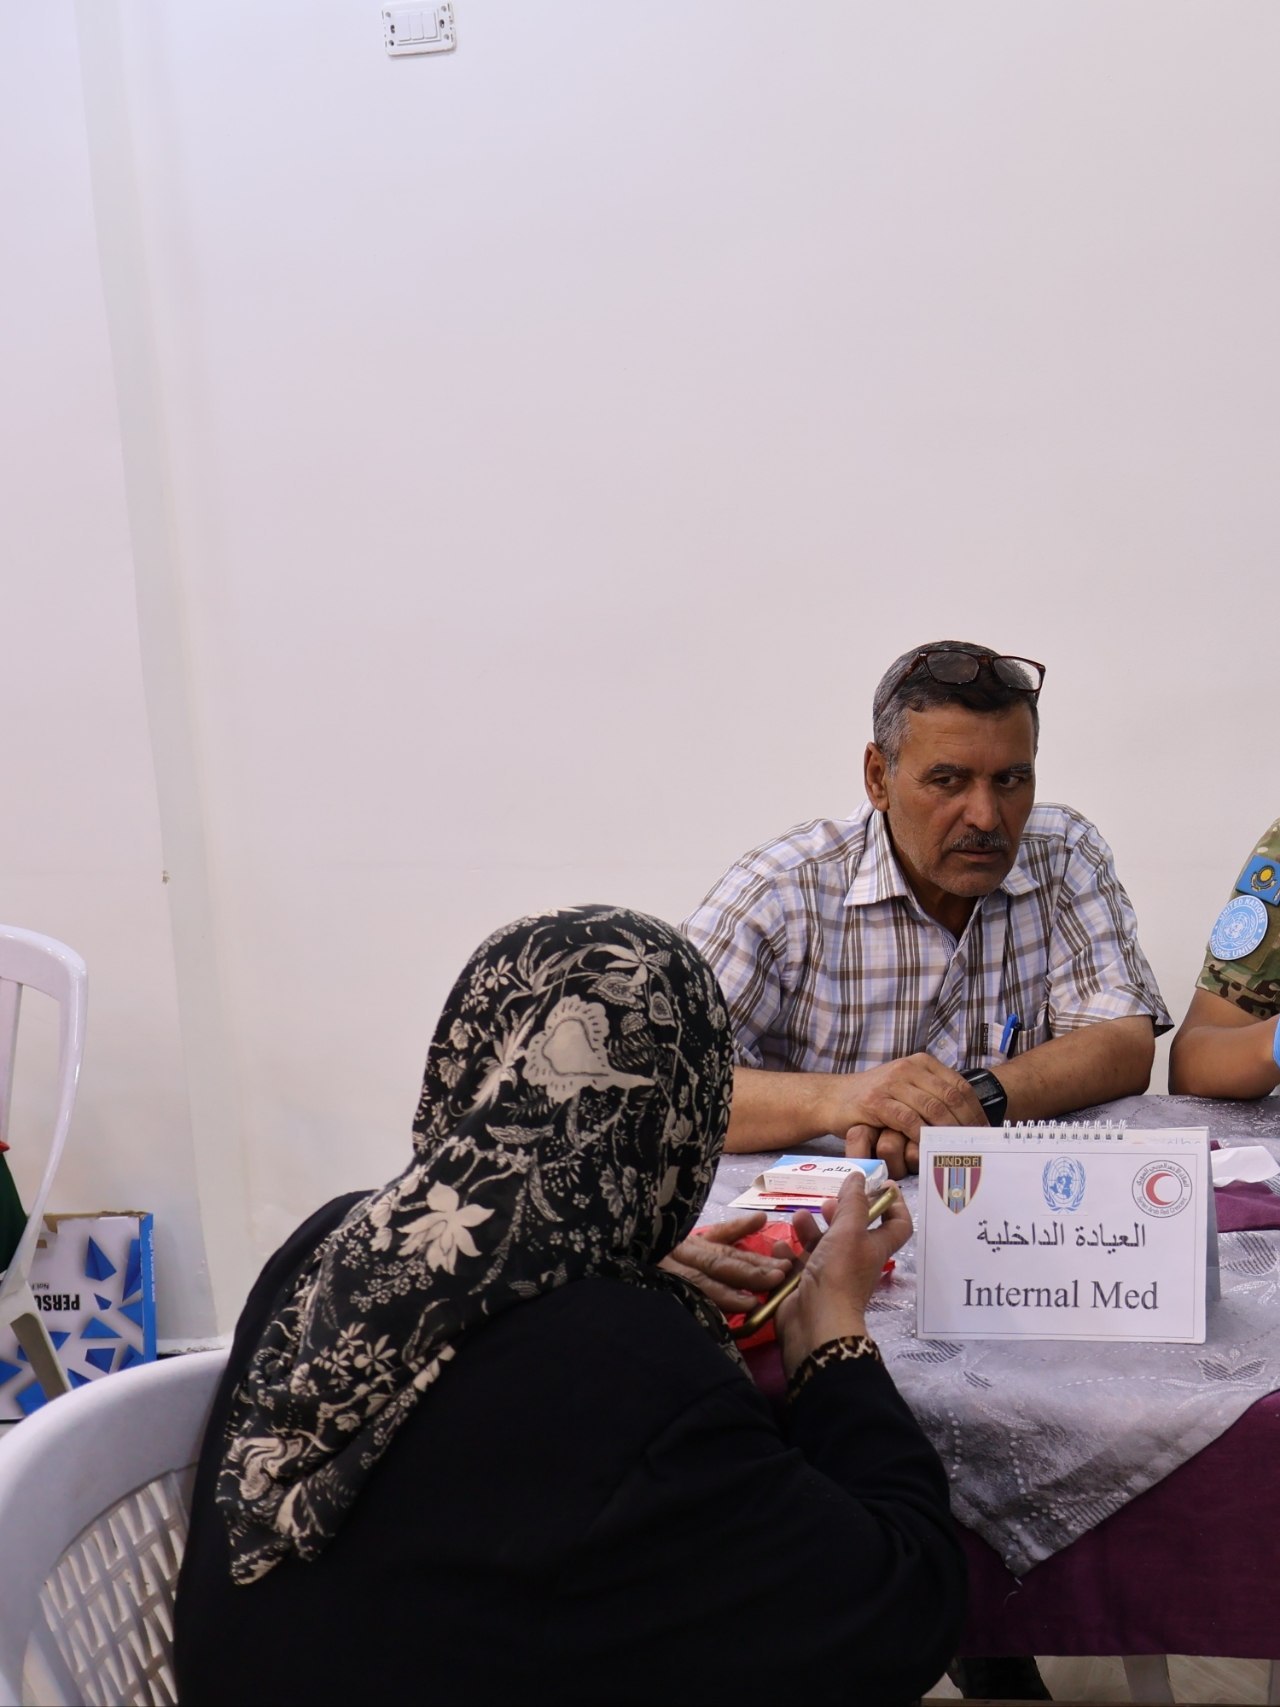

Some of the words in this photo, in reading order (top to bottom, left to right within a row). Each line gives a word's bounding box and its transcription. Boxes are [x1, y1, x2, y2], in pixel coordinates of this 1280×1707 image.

[1219, 898, 1244, 920] UNITED
[1245, 897, 1266, 923] NATIONS
[1232, 939, 1259, 957] UNIES
[936, 1157, 980, 1167] UNDOF
[976, 1219, 1065, 1253] الداخلية
[1075, 1221, 1146, 1255] العيادة
[963, 1278, 1080, 1308] Internal
[1090, 1280, 1159, 1310] Med
